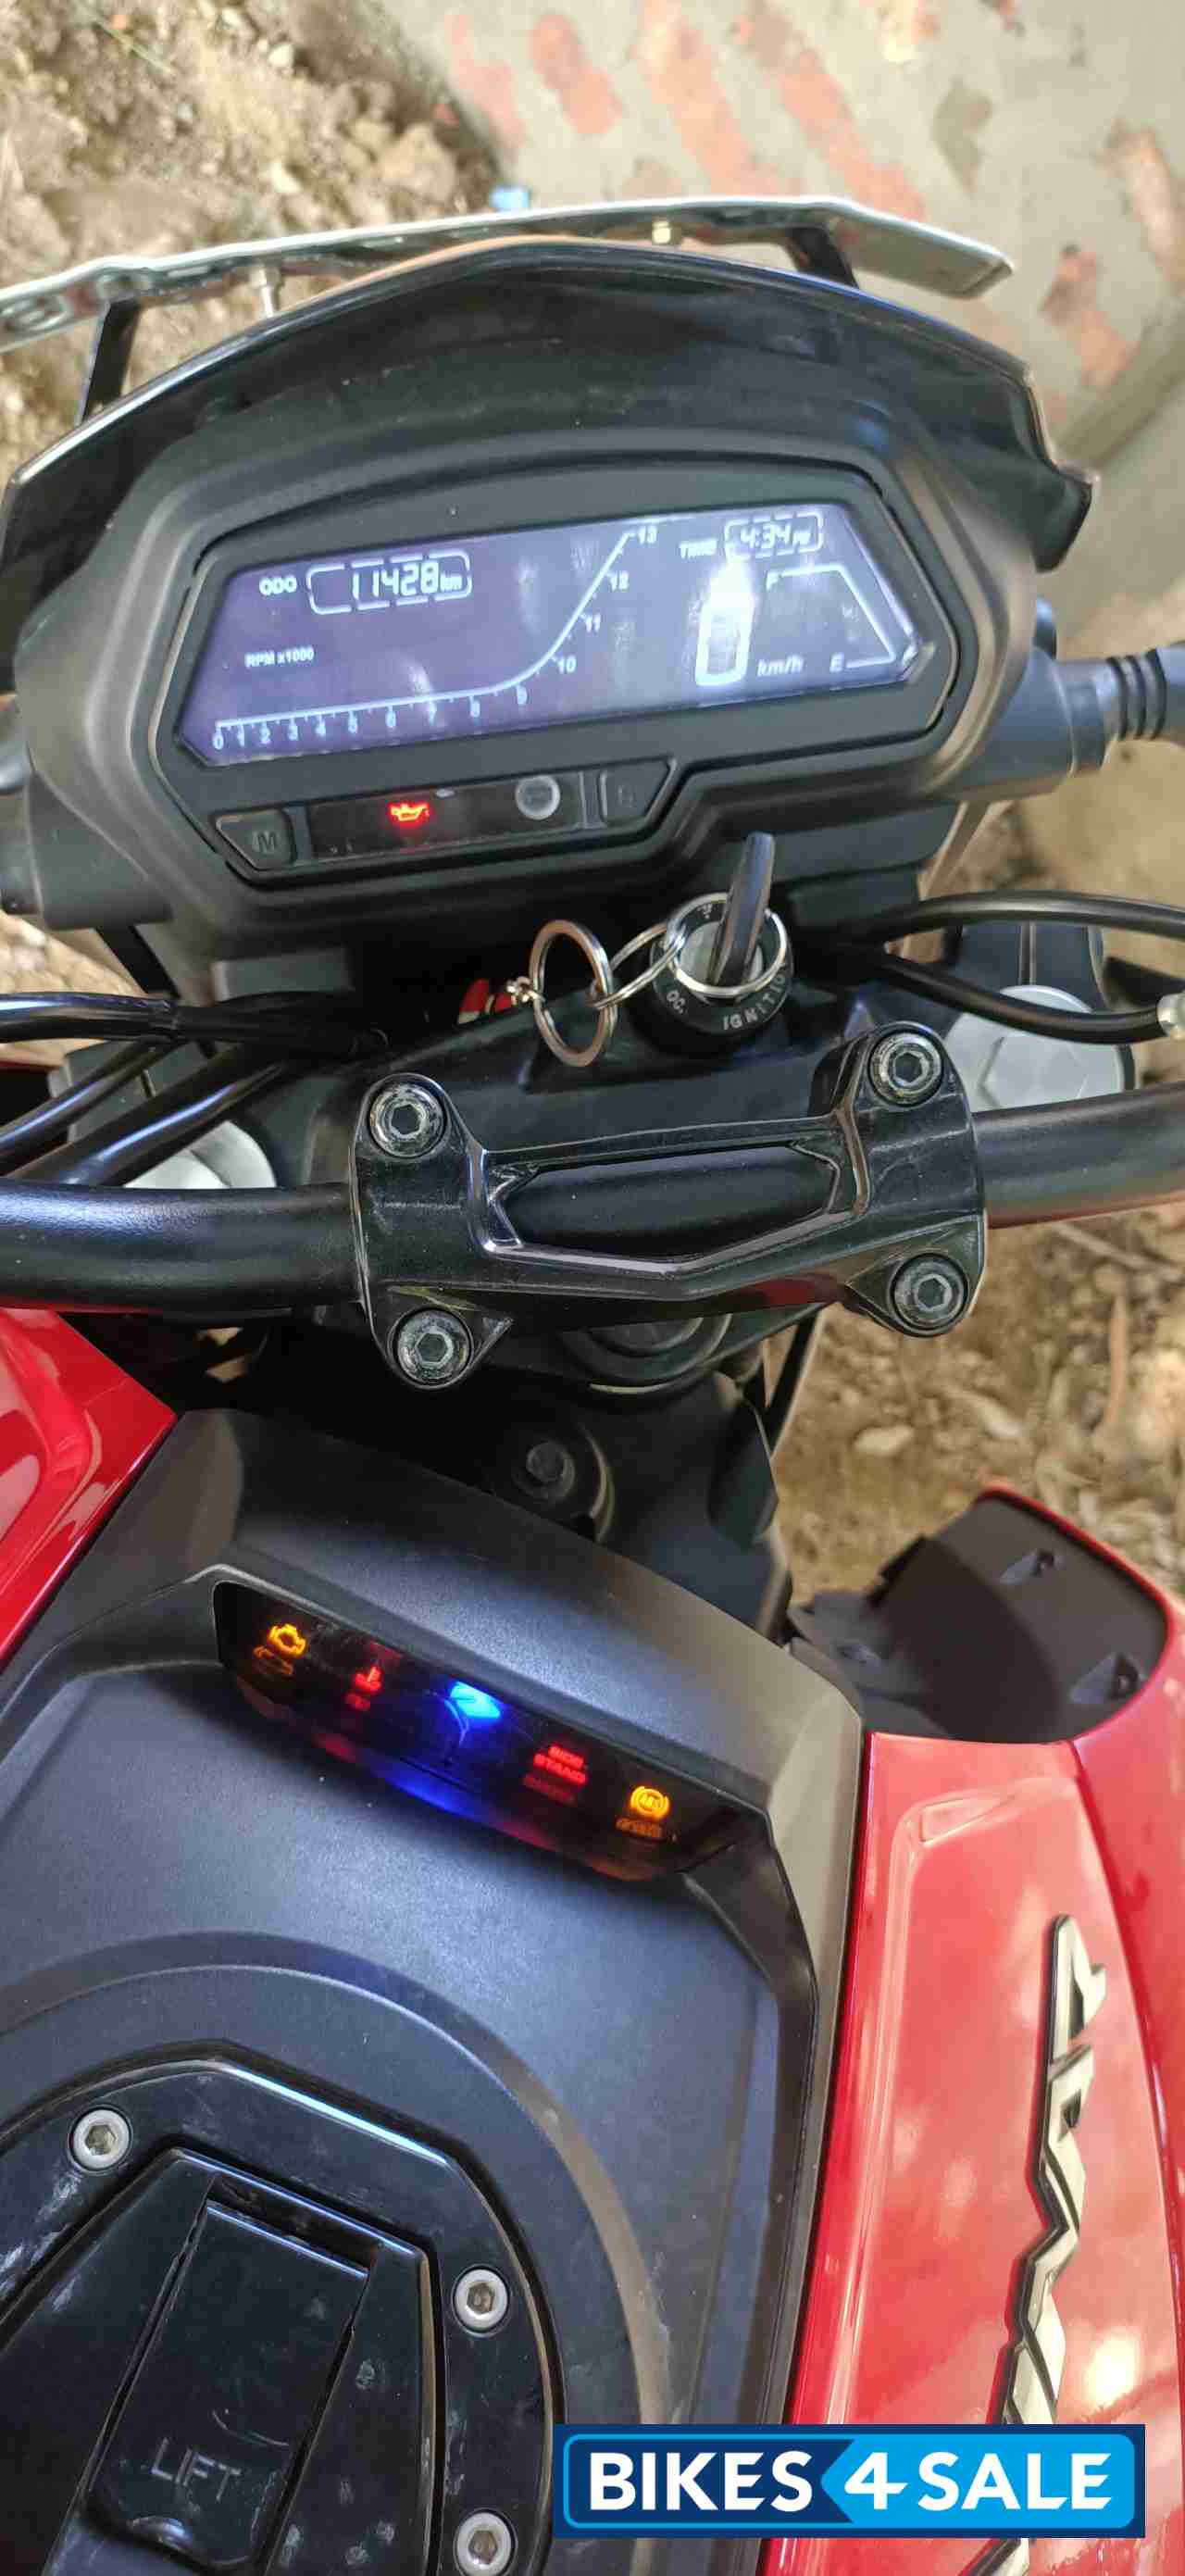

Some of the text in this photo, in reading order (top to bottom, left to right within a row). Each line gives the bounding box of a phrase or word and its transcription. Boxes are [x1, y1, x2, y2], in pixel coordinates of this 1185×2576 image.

[637, 524, 658, 544] 13
[679, 537, 717, 559] TIME
[259, 575, 297, 595] ODO
[610, 570, 630, 591] 12
[244, 651, 275, 669] RPM
[557, 654, 577, 674] 10
[756, 652, 804, 677] km/h
[829, 652, 844, 673] E
[212, 731, 224, 750] 0
[722, 967, 787, 1031] IGNITIO
[147, 2436, 243, 2502] LIFT
